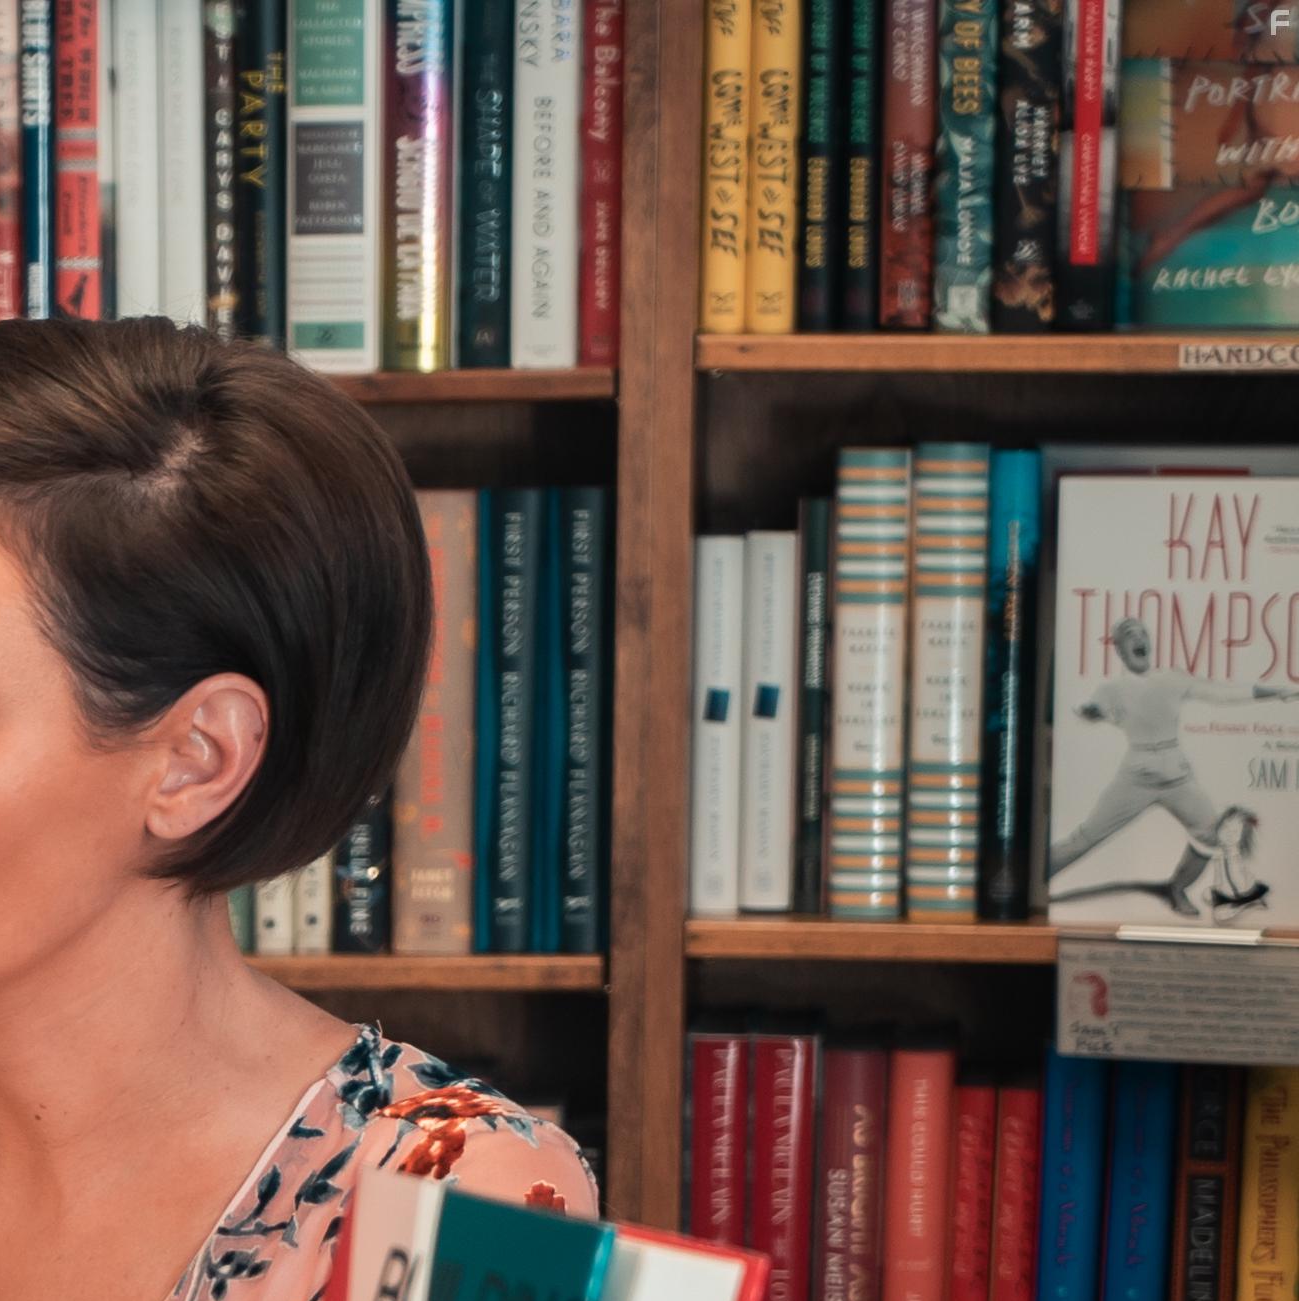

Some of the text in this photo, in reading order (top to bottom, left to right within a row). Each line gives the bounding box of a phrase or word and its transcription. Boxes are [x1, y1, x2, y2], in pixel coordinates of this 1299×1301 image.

[953, 21, 982, 49] OF
[587, 43, 619, 144] Balcony
[953, 56, 982, 115] BEES
[239, 70, 266, 188] PARTY
[531, 95, 556, 321] BEFORE AND AGAIN
[710, 207, 740, 259] SEE
[757, 207, 787, 259] SEE
[1153, 264, 1254, 291] RACHEL
[503, 511, 524, 568] FIRST
[571, 508, 590, 565] FIRST
[1163, 492, 1260, 581] KAY
[502, 573, 523, 657] PERSON
[569, 571, 590, 655] PERSON
[1248, 756, 1288, 792] SAM
[827, 1168, 848, 1248] SUSAN
